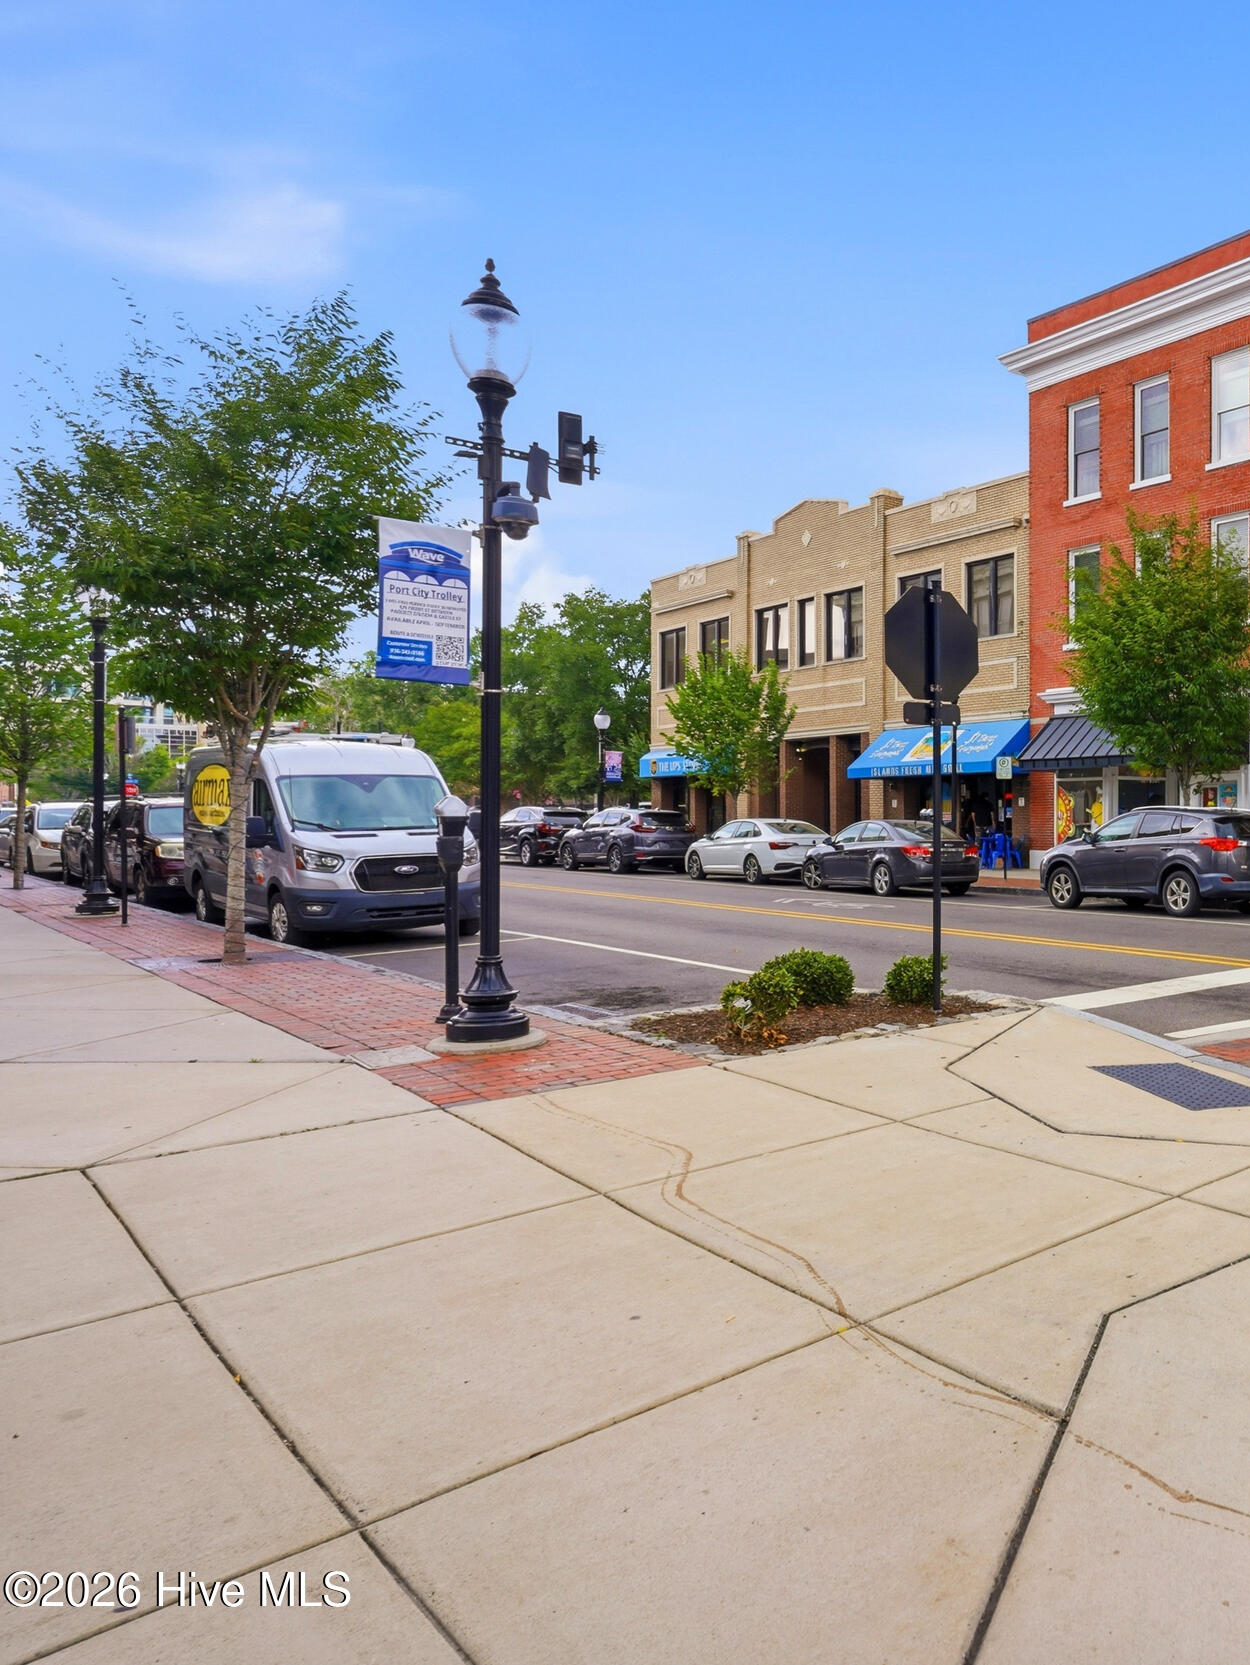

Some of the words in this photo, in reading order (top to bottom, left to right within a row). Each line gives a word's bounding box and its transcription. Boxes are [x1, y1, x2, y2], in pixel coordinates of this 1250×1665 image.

[408, 548, 445, 562] Wave
[389, 584, 409, 596] Port
[412, 587, 430, 599] City
[431, 590, 463, 603] Trolley
[670, 761, 681, 772] UPS
[871, 767, 900, 777] ISLANDS
[901, 765, 922, 776] FRESH
[943, 763, 963, 774] GRLL
